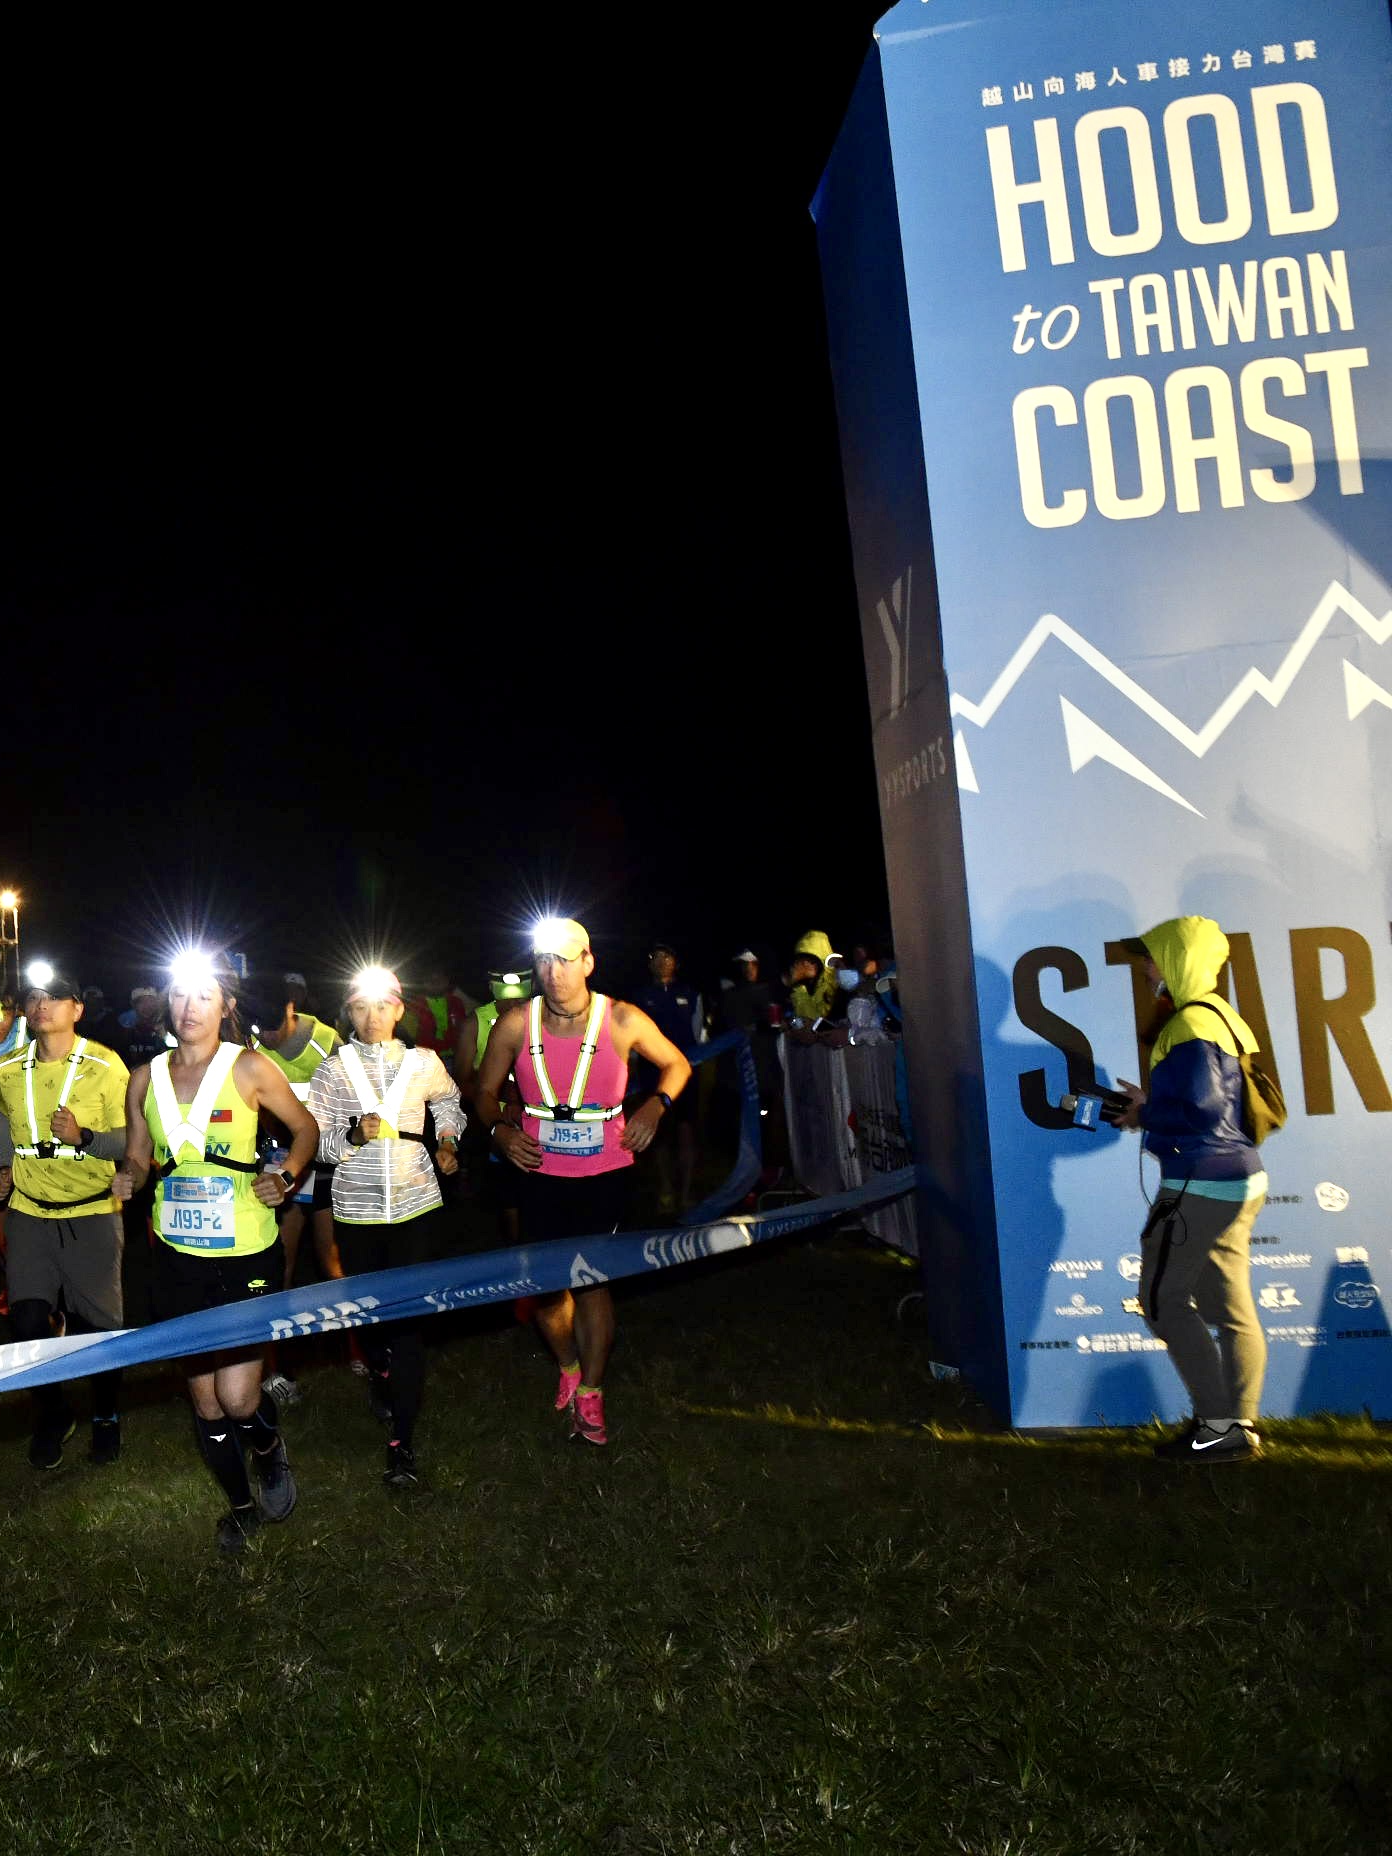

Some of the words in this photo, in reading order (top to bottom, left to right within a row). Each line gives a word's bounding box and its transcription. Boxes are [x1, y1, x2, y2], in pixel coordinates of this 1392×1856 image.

[981, 39, 1318, 107] 越山向海人車接力台灣賽
[985, 82, 1340, 273] HOOD
[1011, 304, 1080, 355] to
[1088, 250, 1355, 360] TAIWAN
[1011, 347, 1369, 529] COAST
[169, 1209, 223, 1230] J193-2
